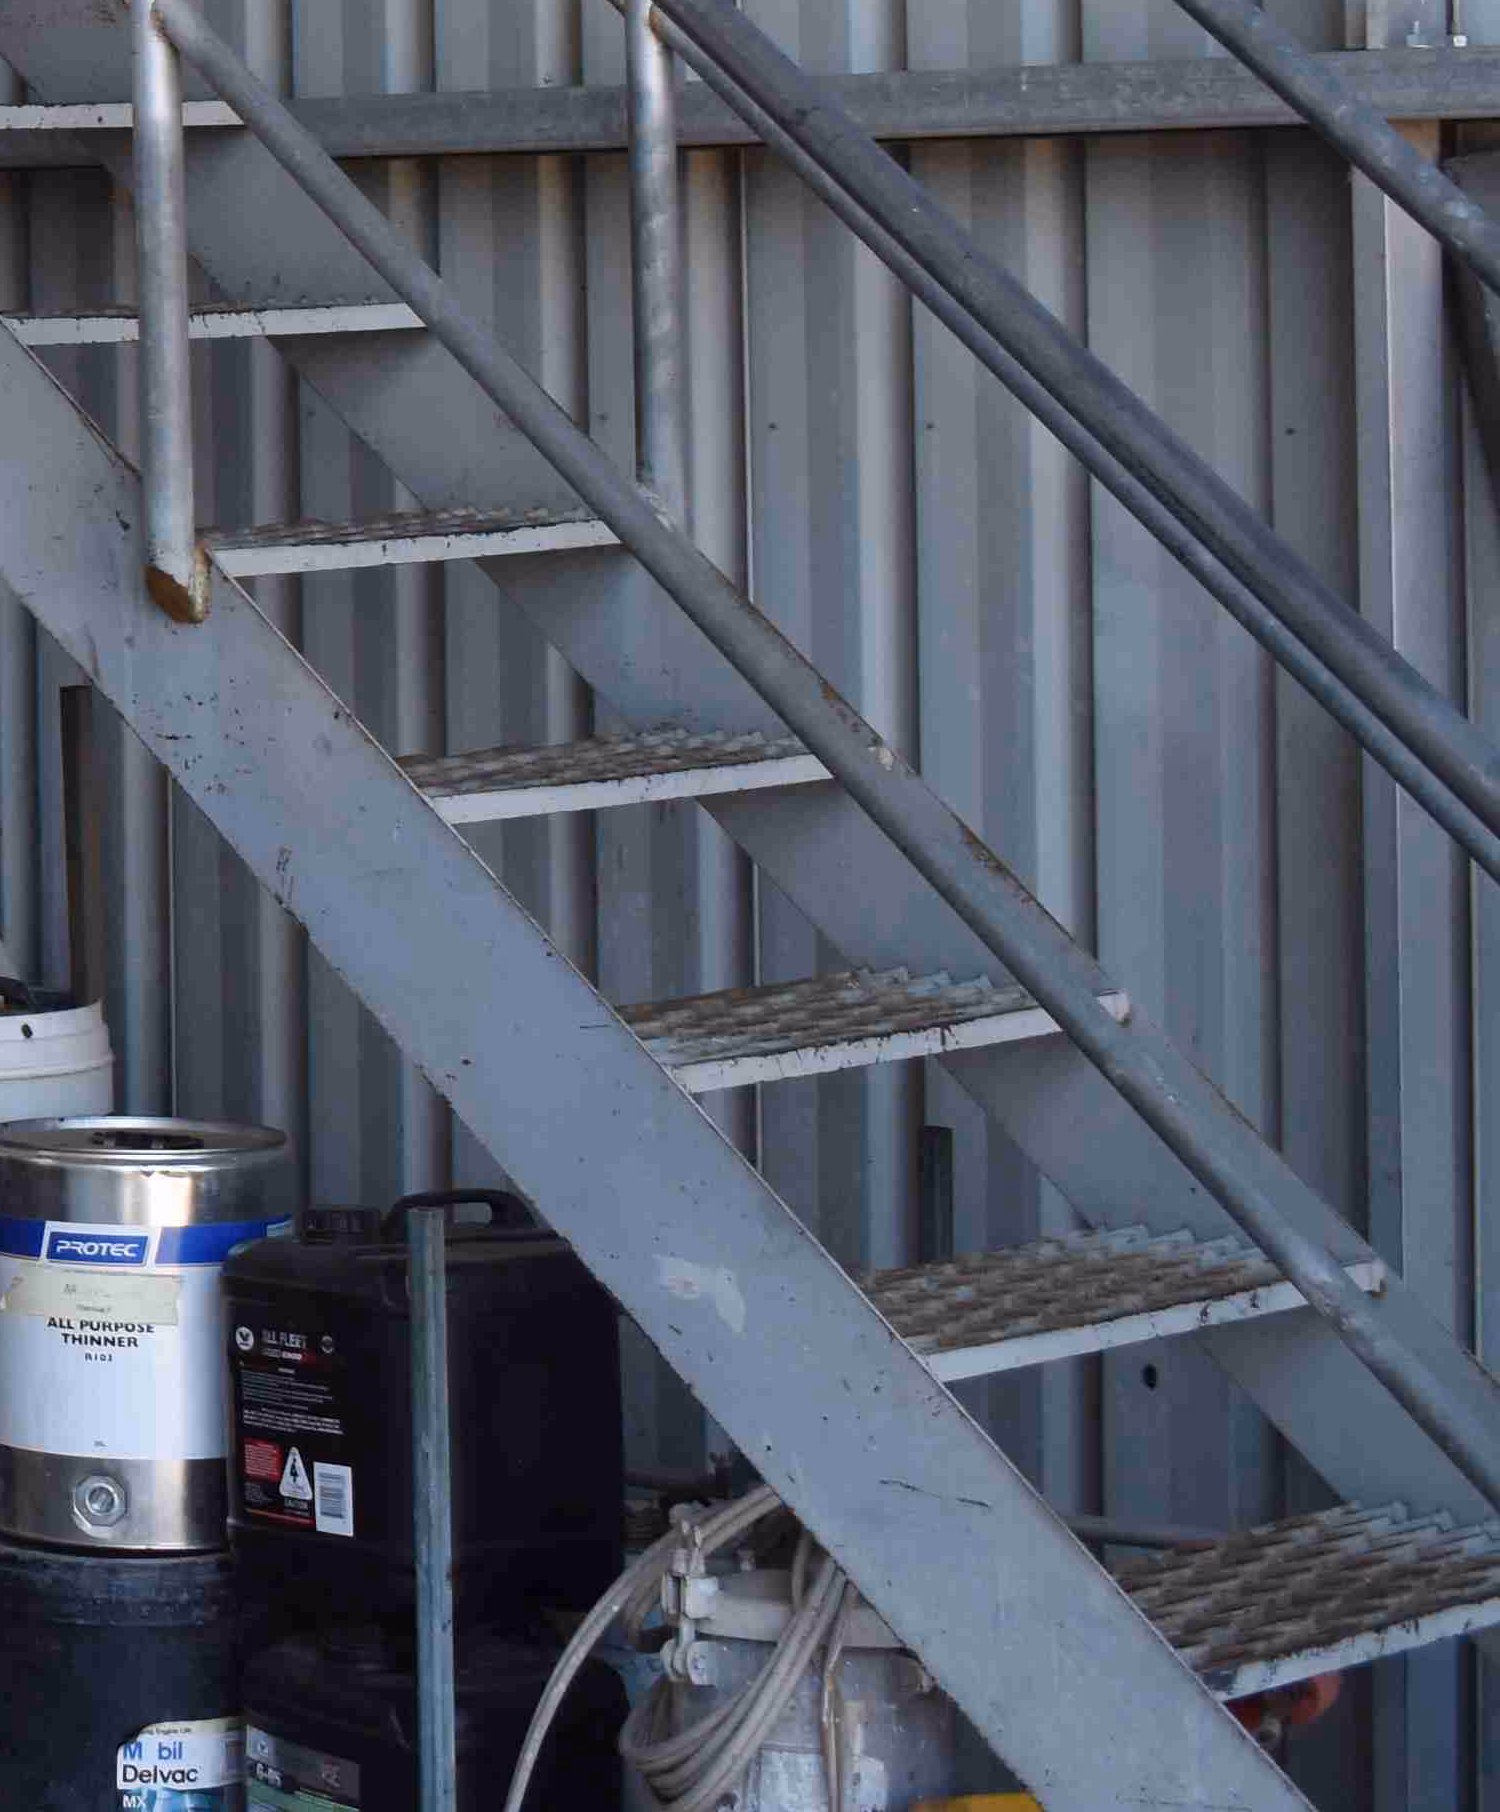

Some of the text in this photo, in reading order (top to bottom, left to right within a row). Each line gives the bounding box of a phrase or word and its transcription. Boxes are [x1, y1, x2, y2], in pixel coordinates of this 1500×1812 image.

[55, 1239, 141, 1258] PROTEC
[46, 1317, 156, 1334] ALL PURPOSE
[61, 1333, 139, 1349] THINNER
[123, 1741, 183, 1760] Mbil
[122, 1765, 199, 1784] Delvac
[123, 1795, 146, 1808] MX
